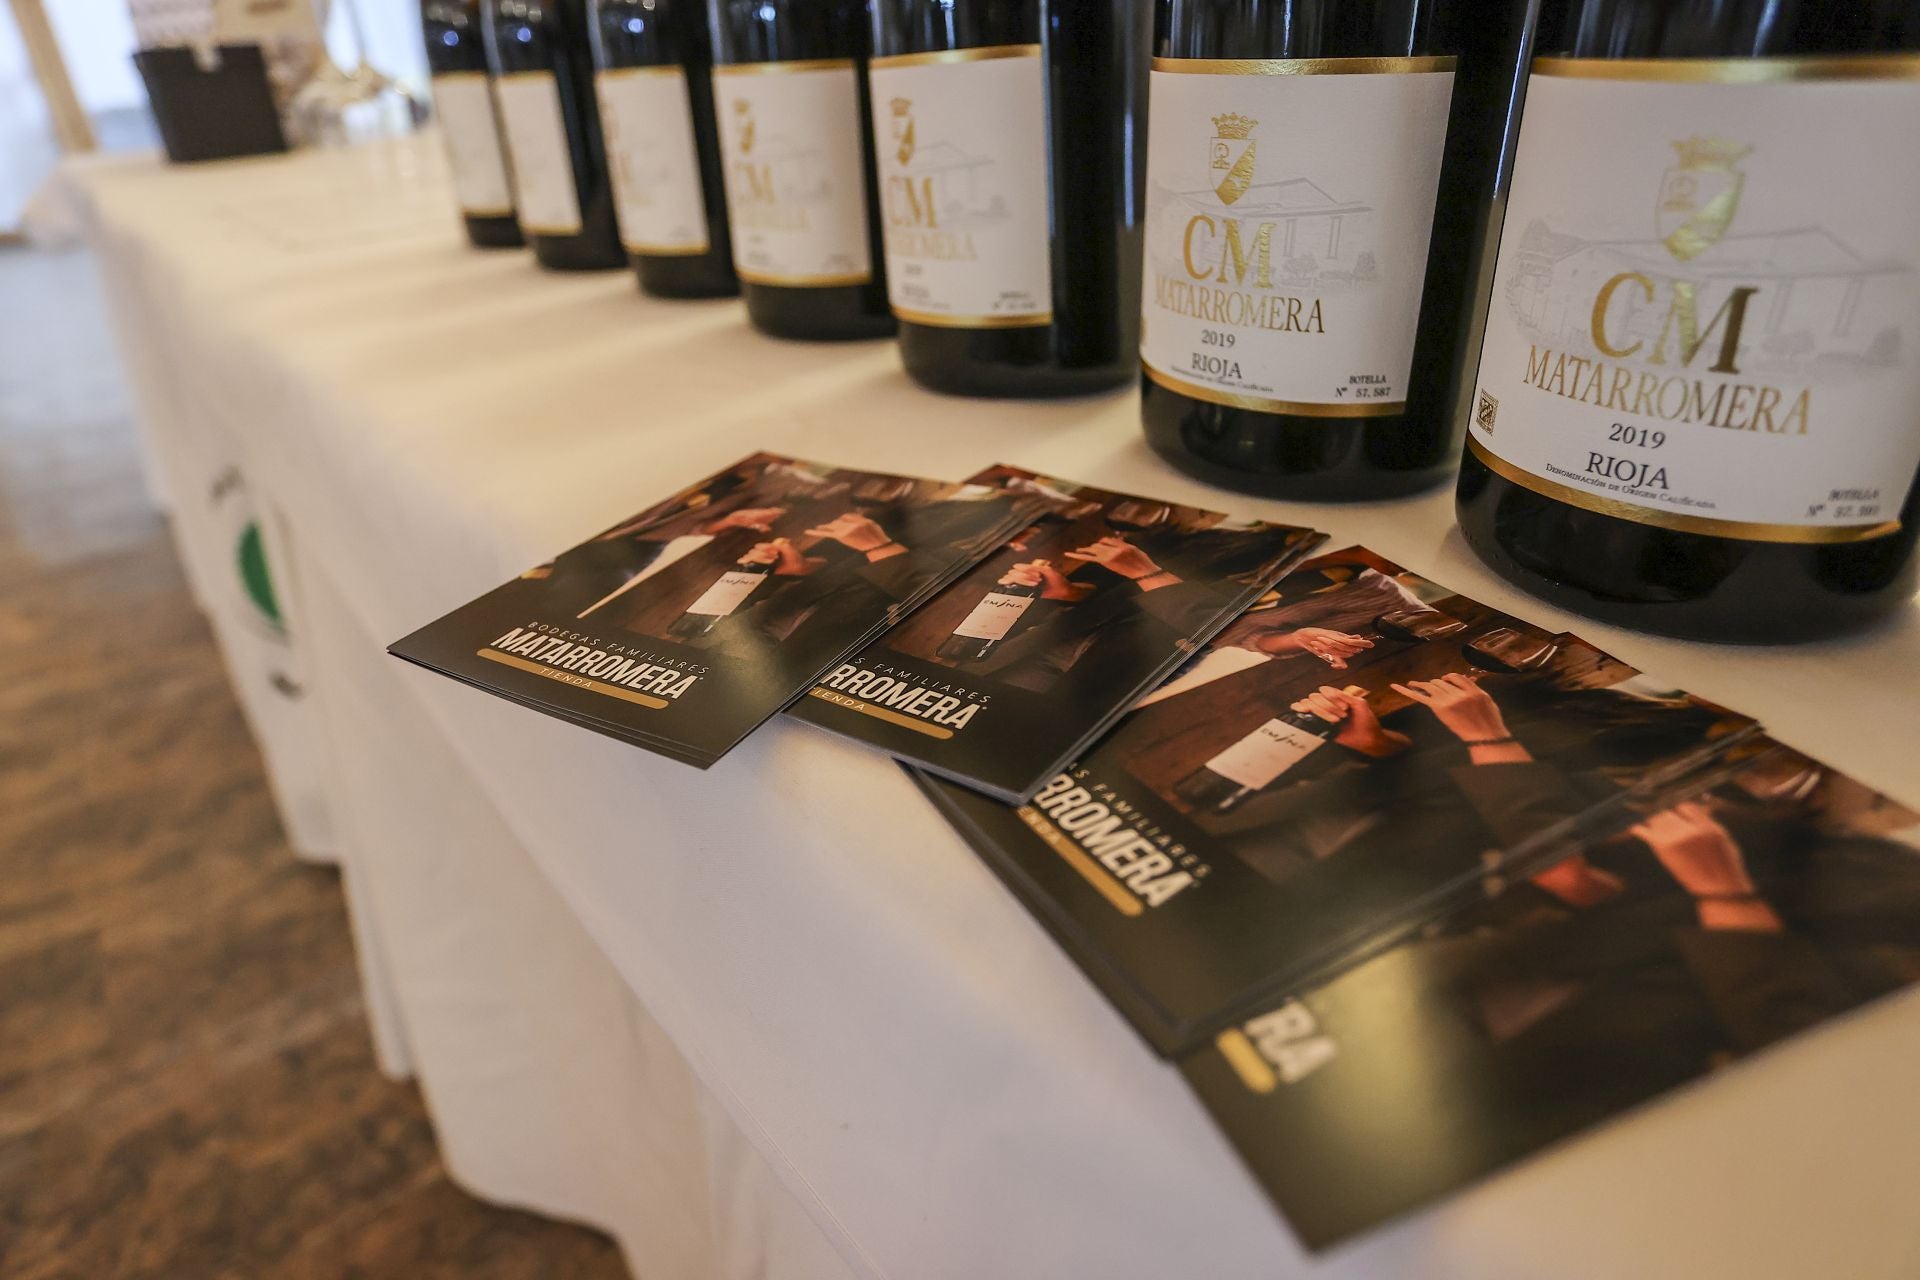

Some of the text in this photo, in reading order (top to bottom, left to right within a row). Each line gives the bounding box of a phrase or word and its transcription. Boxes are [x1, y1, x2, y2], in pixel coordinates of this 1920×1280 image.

[1183, 214, 1277, 289] CM
[1155, 273, 1325, 334] MATARROMERA
[1590, 271, 1759, 375] CM
[1201, 329, 1236, 348] 2019
[1192, 352, 1242, 380] RIOJA
[1522, 344, 1812, 436] MATARROMERA
[1608, 422, 1666, 450] 2019
[1585, 451, 1669, 490] RIOJA
[490, 627, 702, 700] MATARROMERA
[527, 621, 711, 675] BODEGAS FAMILIARES
[540, 667, 593, 688] TIENDA
[874, 663, 992, 704] FAMILIARES
[813, 687, 866, 711] IENDA
